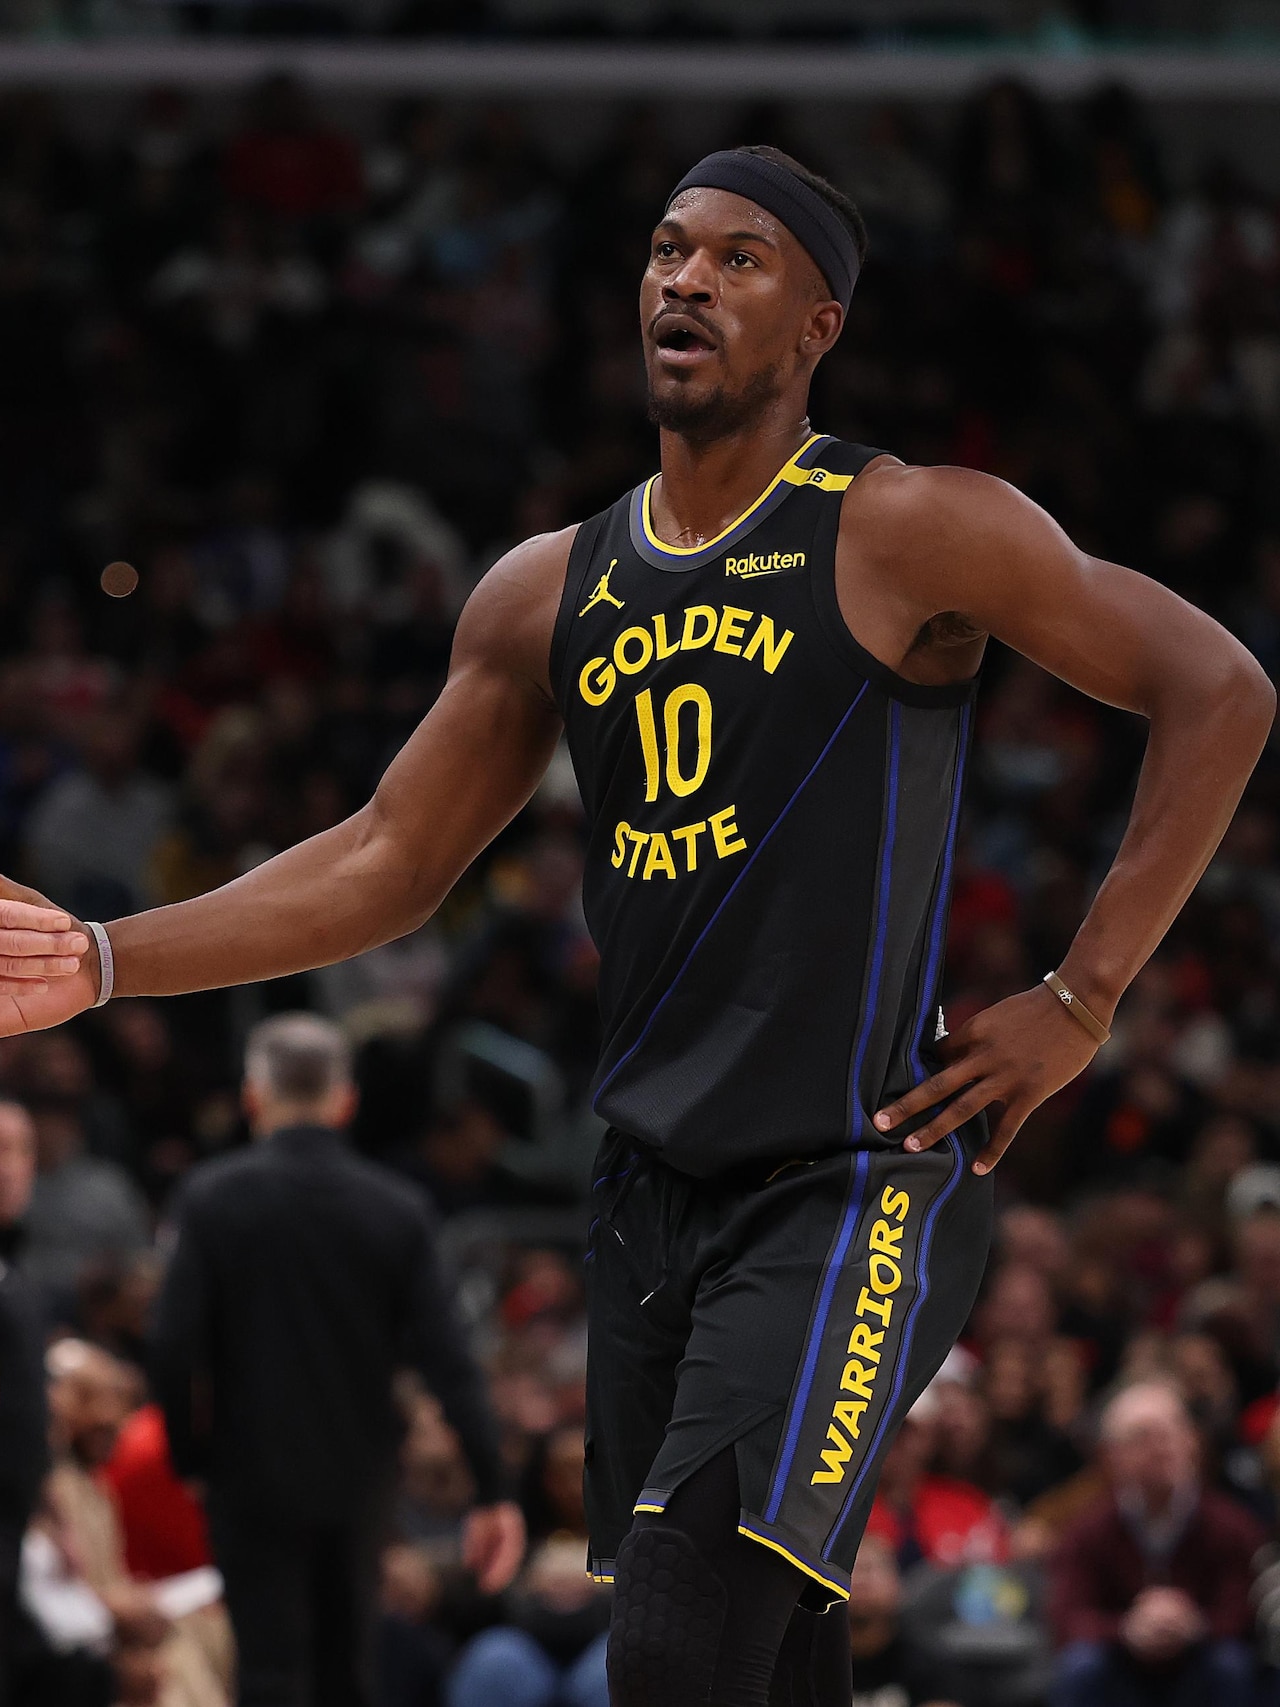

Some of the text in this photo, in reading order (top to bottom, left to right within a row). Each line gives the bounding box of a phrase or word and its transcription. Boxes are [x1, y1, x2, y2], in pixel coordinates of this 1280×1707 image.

[725, 551, 806, 577] Rakuten
[579, 605, 795, 706] GOLDEN
[635, 683, 713, 803] 10
[611, 804, 748, 880] STATE
[811, 1185, 910, 1486] WARRIORS
